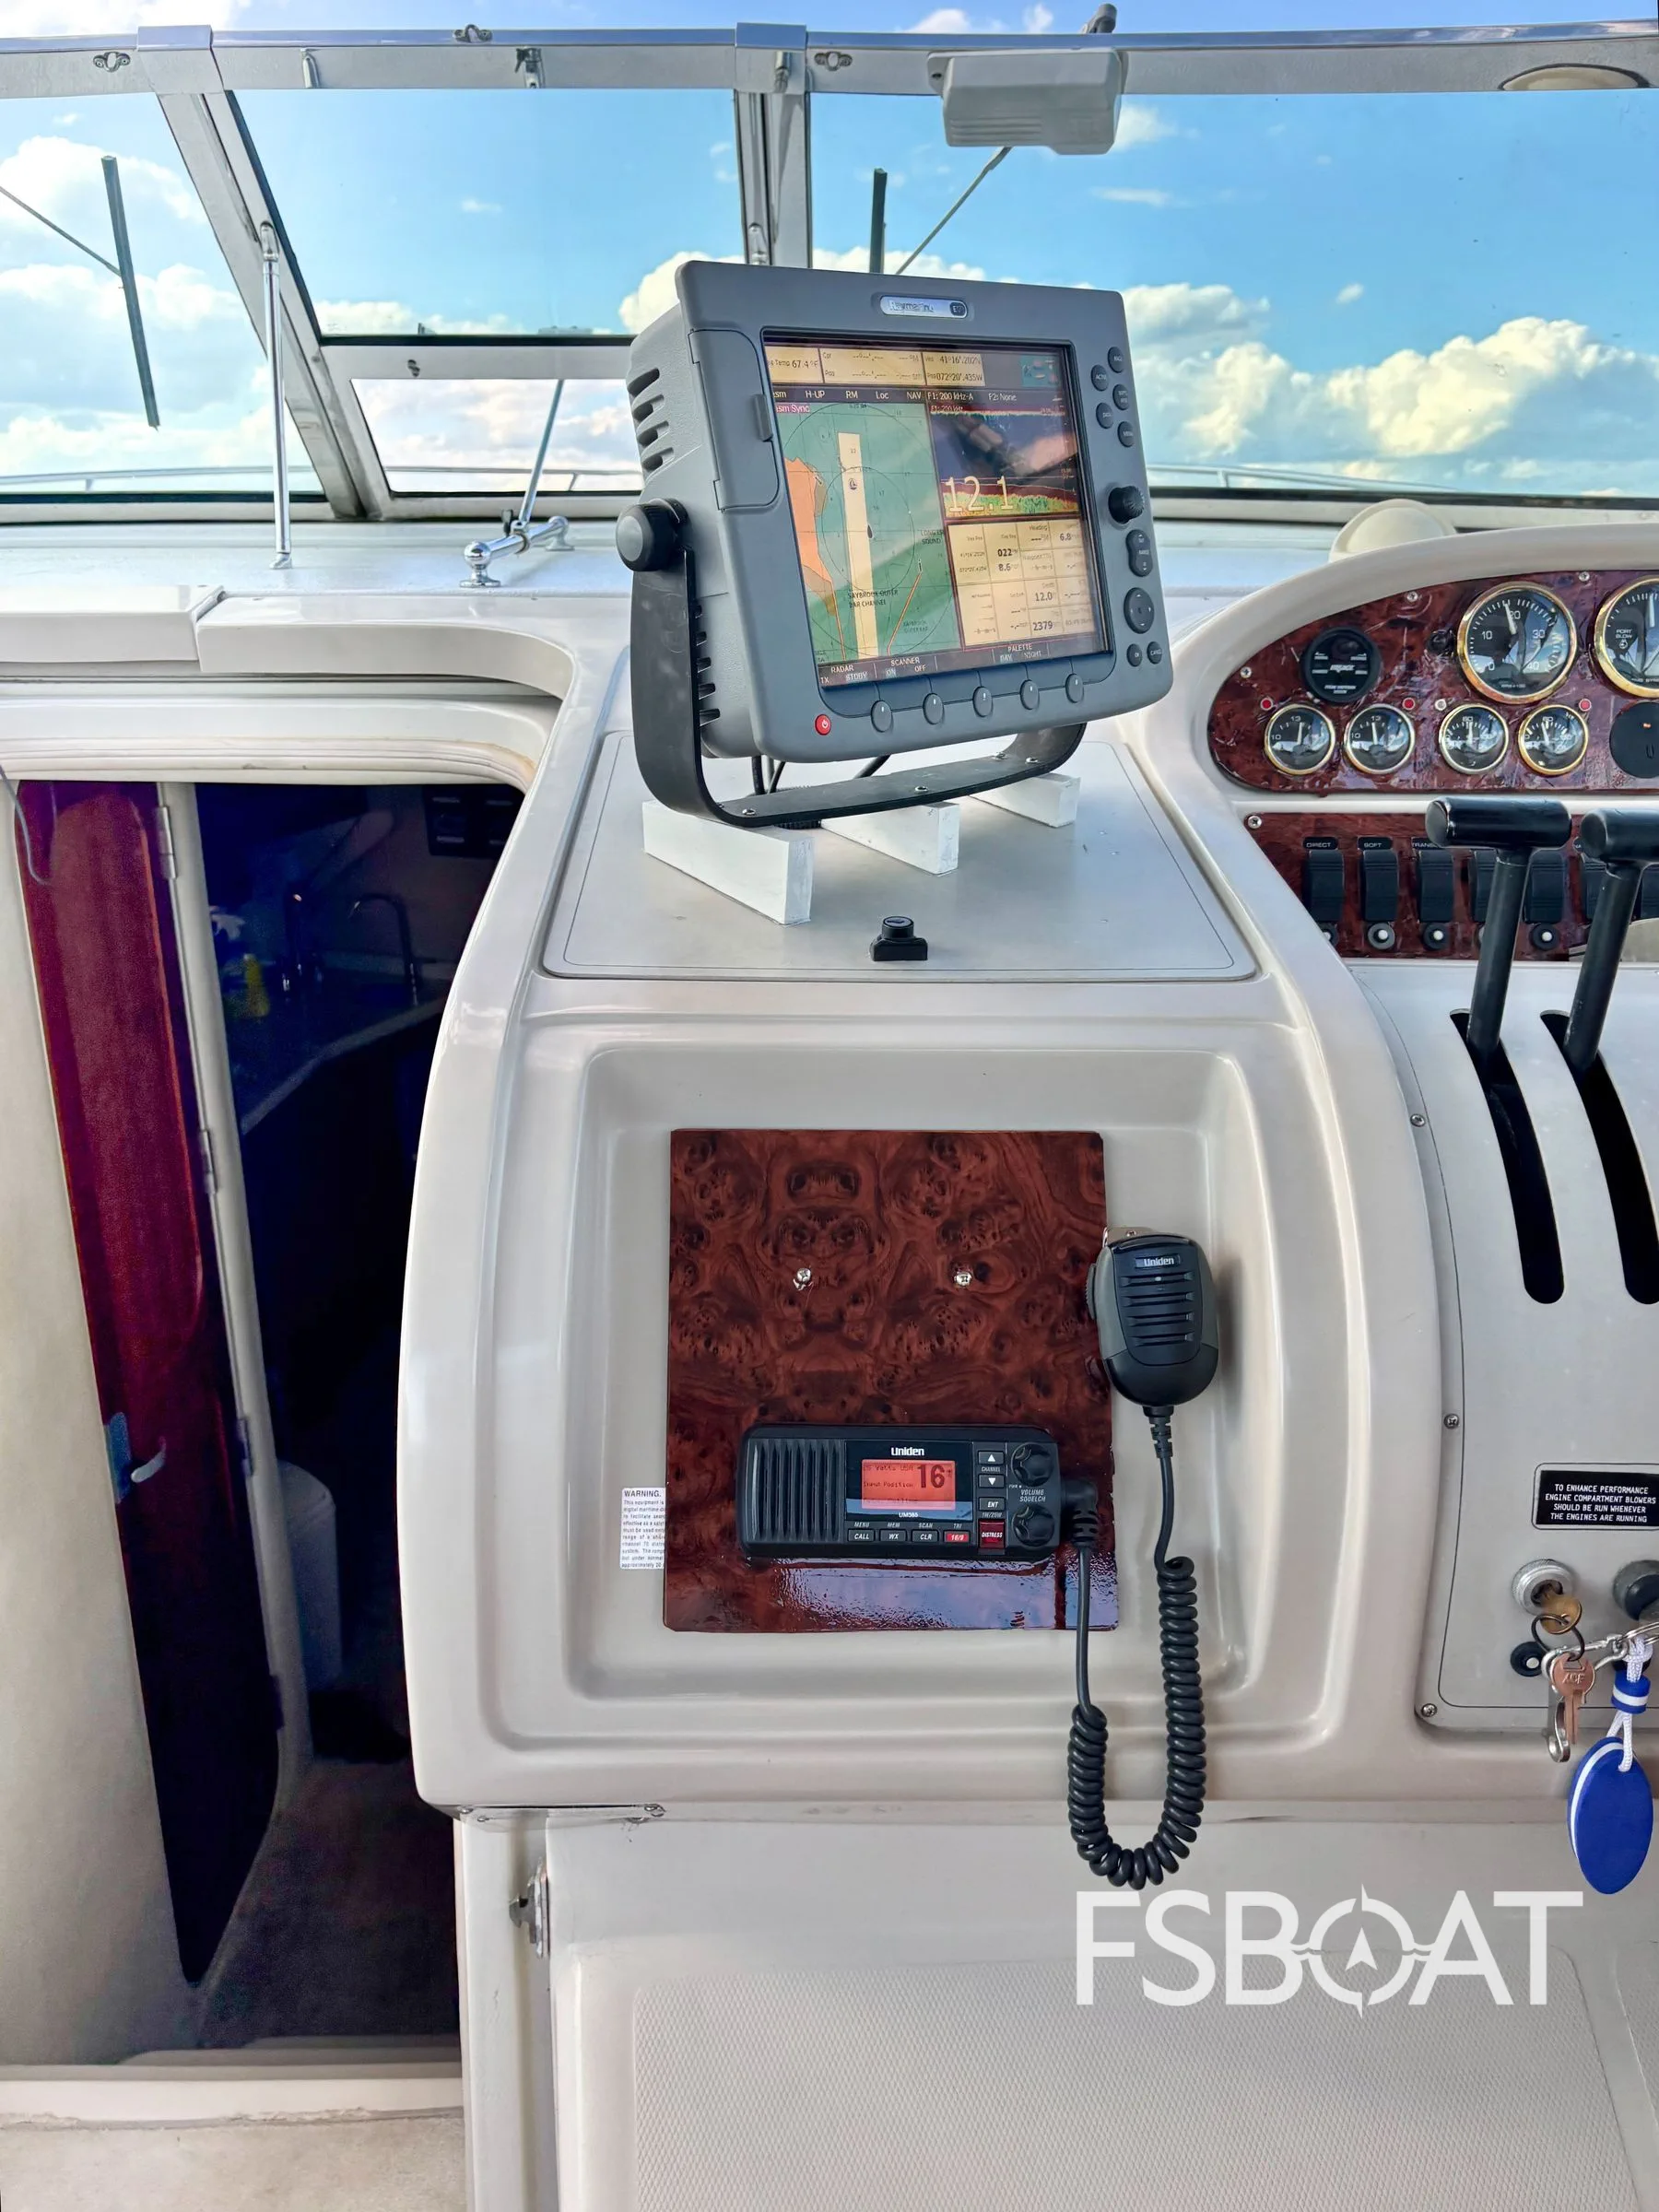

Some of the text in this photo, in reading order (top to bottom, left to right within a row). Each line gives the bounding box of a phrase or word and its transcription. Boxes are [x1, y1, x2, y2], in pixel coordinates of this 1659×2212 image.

[805, 391, 826, 399] H-UP
[845, 391, 858, 399] RM
[876, 392, 889, 400] Loc
[906, 392, 922, 400] NAV
[940, 392, 952, 400] 200
[791, 404, 810, 414] Sync
[946, 475, 1014, 512] 12.1
[1059, 533, 1072, 541] 6.8
[997, 548, 1012, 557] 022
[998, 563, 1011, 571] 8.6
[1035, 592, 1053, 601] 12.0
[1033, 621, 1053, 631] 2379
[1482, 630, 1492, 641] 10
[1533, 629, 1546, 639] 30
[1007, 643, 1032, 653] PALETTE
[890, 656, 921, 667] SCANNER
[831, 665, 854, 674] RADAR
[914, 665, 926, 673] OFF
[1143, 1257, 1175, 1267] Uniden
[890, 1446, 925, 1456] Uniden
[917, 1464, 946, 1488] 16
[624, 1489, 662, 1498] WARNING.
[1554, 1483, 1649, 1495] TO ENHANCE PERFORMANCE
[1545, 1493, 1572, 1501] ENGINE
[1573, 1495, 1623, 1503] COMPARTMENT
[1553, 1503, 1580, 1512] SHOULD
[1610, 1505, 1646, 1513] WHENEVER
[1550, 1512, 1564, 1521] THE
[1566, 1513, 1597, 1522] ENGINES
[1616, 1515, 1647, 1524] RUNNING
